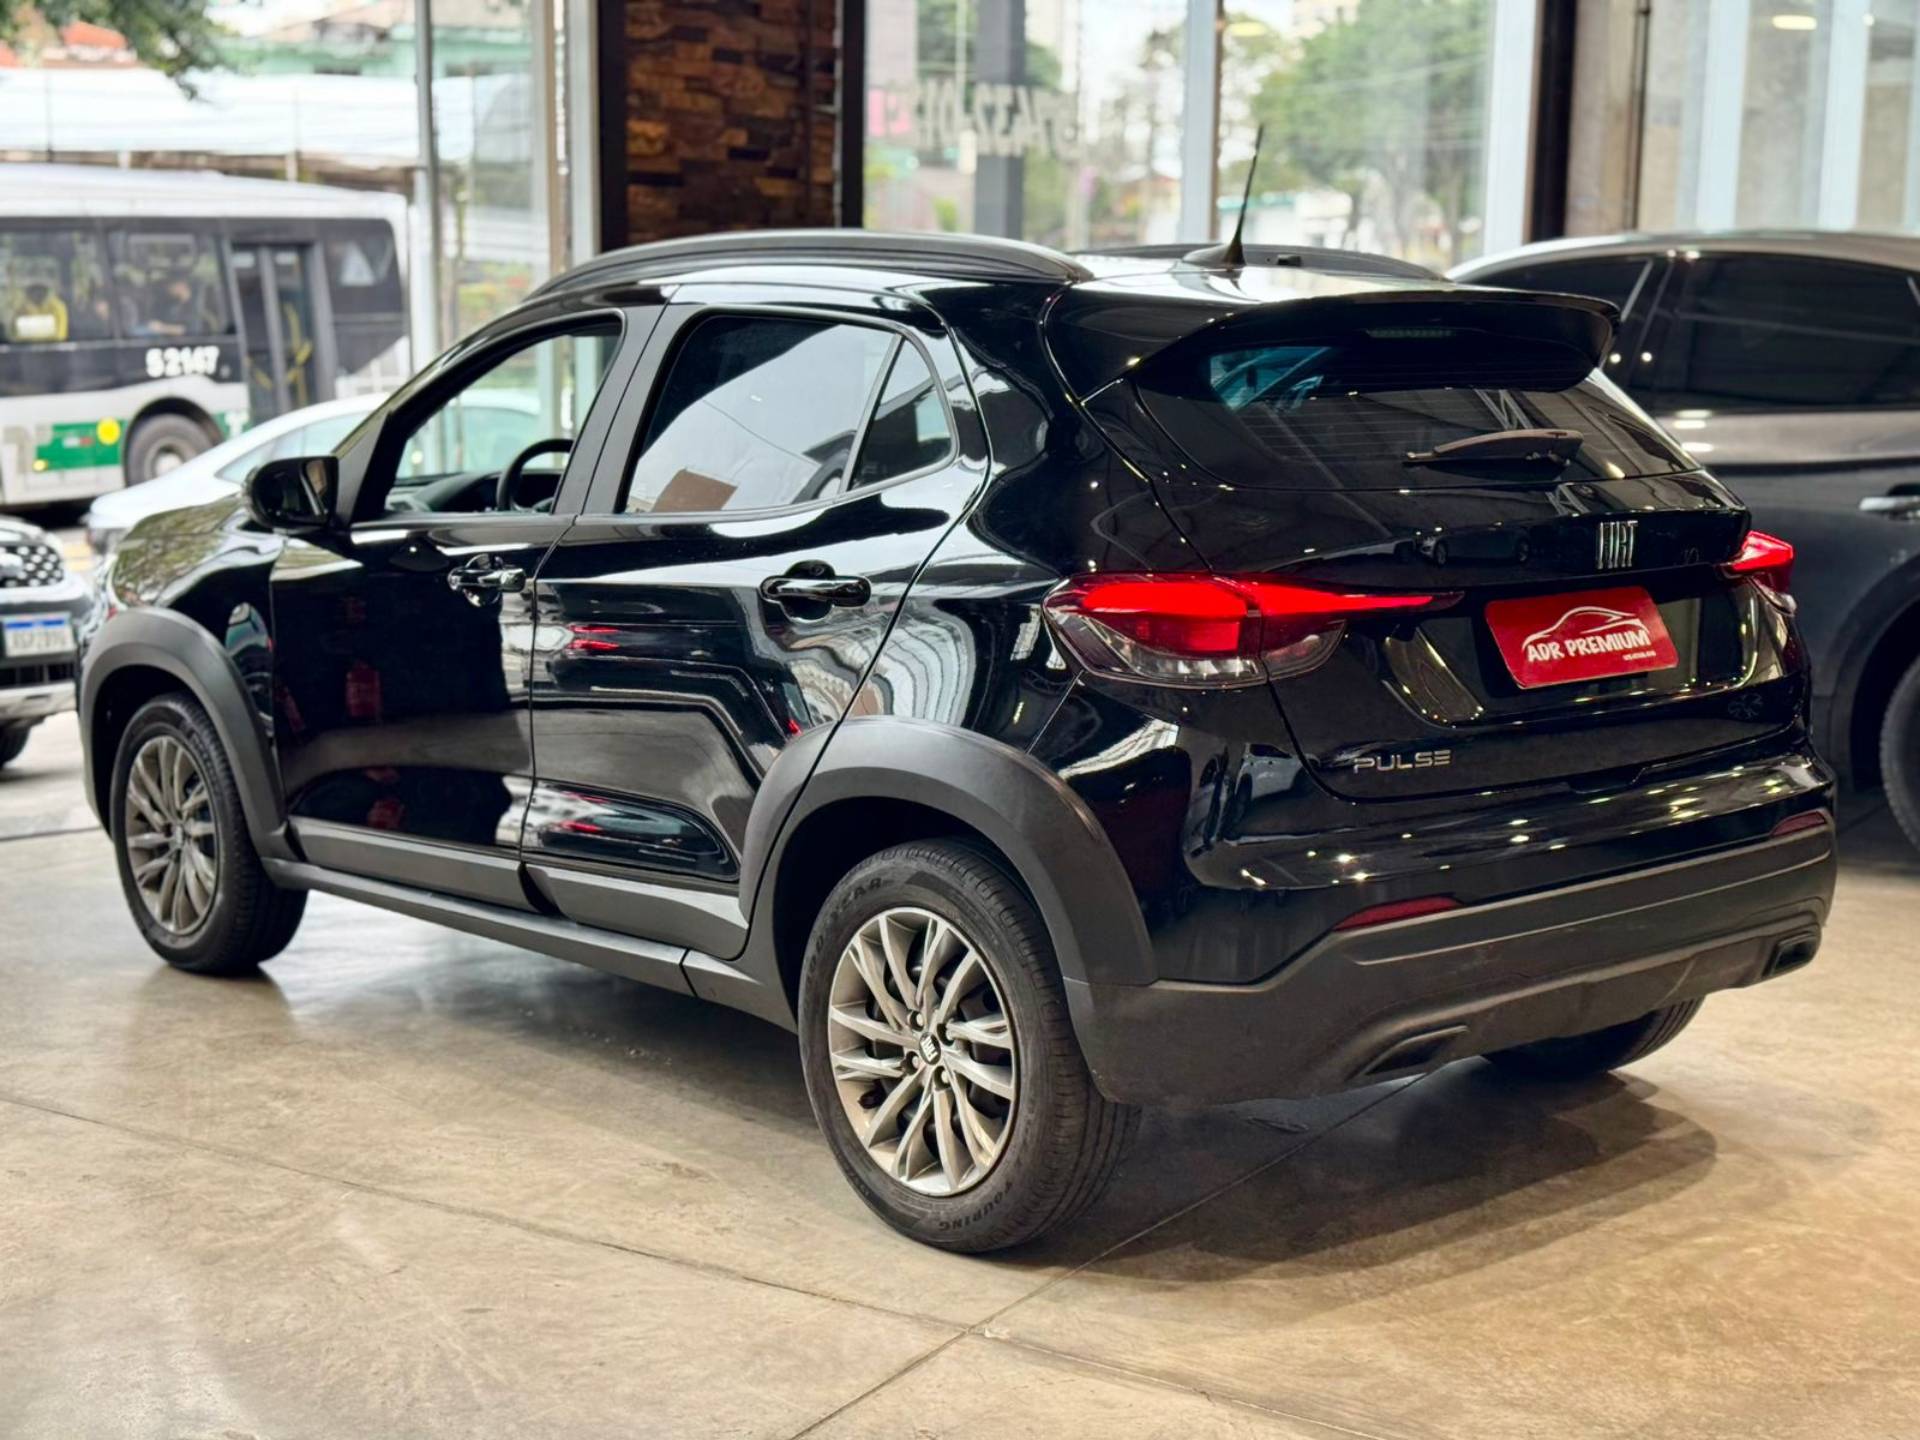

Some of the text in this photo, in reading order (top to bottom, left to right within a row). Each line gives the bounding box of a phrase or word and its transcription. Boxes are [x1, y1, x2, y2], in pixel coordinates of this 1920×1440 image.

[1598, 520, 1638, 569] FIAT
[1527, 641, 1565, 662] ADR
[1564, 629, 1651, 657] PREMIUM
[1353, 749, 1451, 774] PULSE
